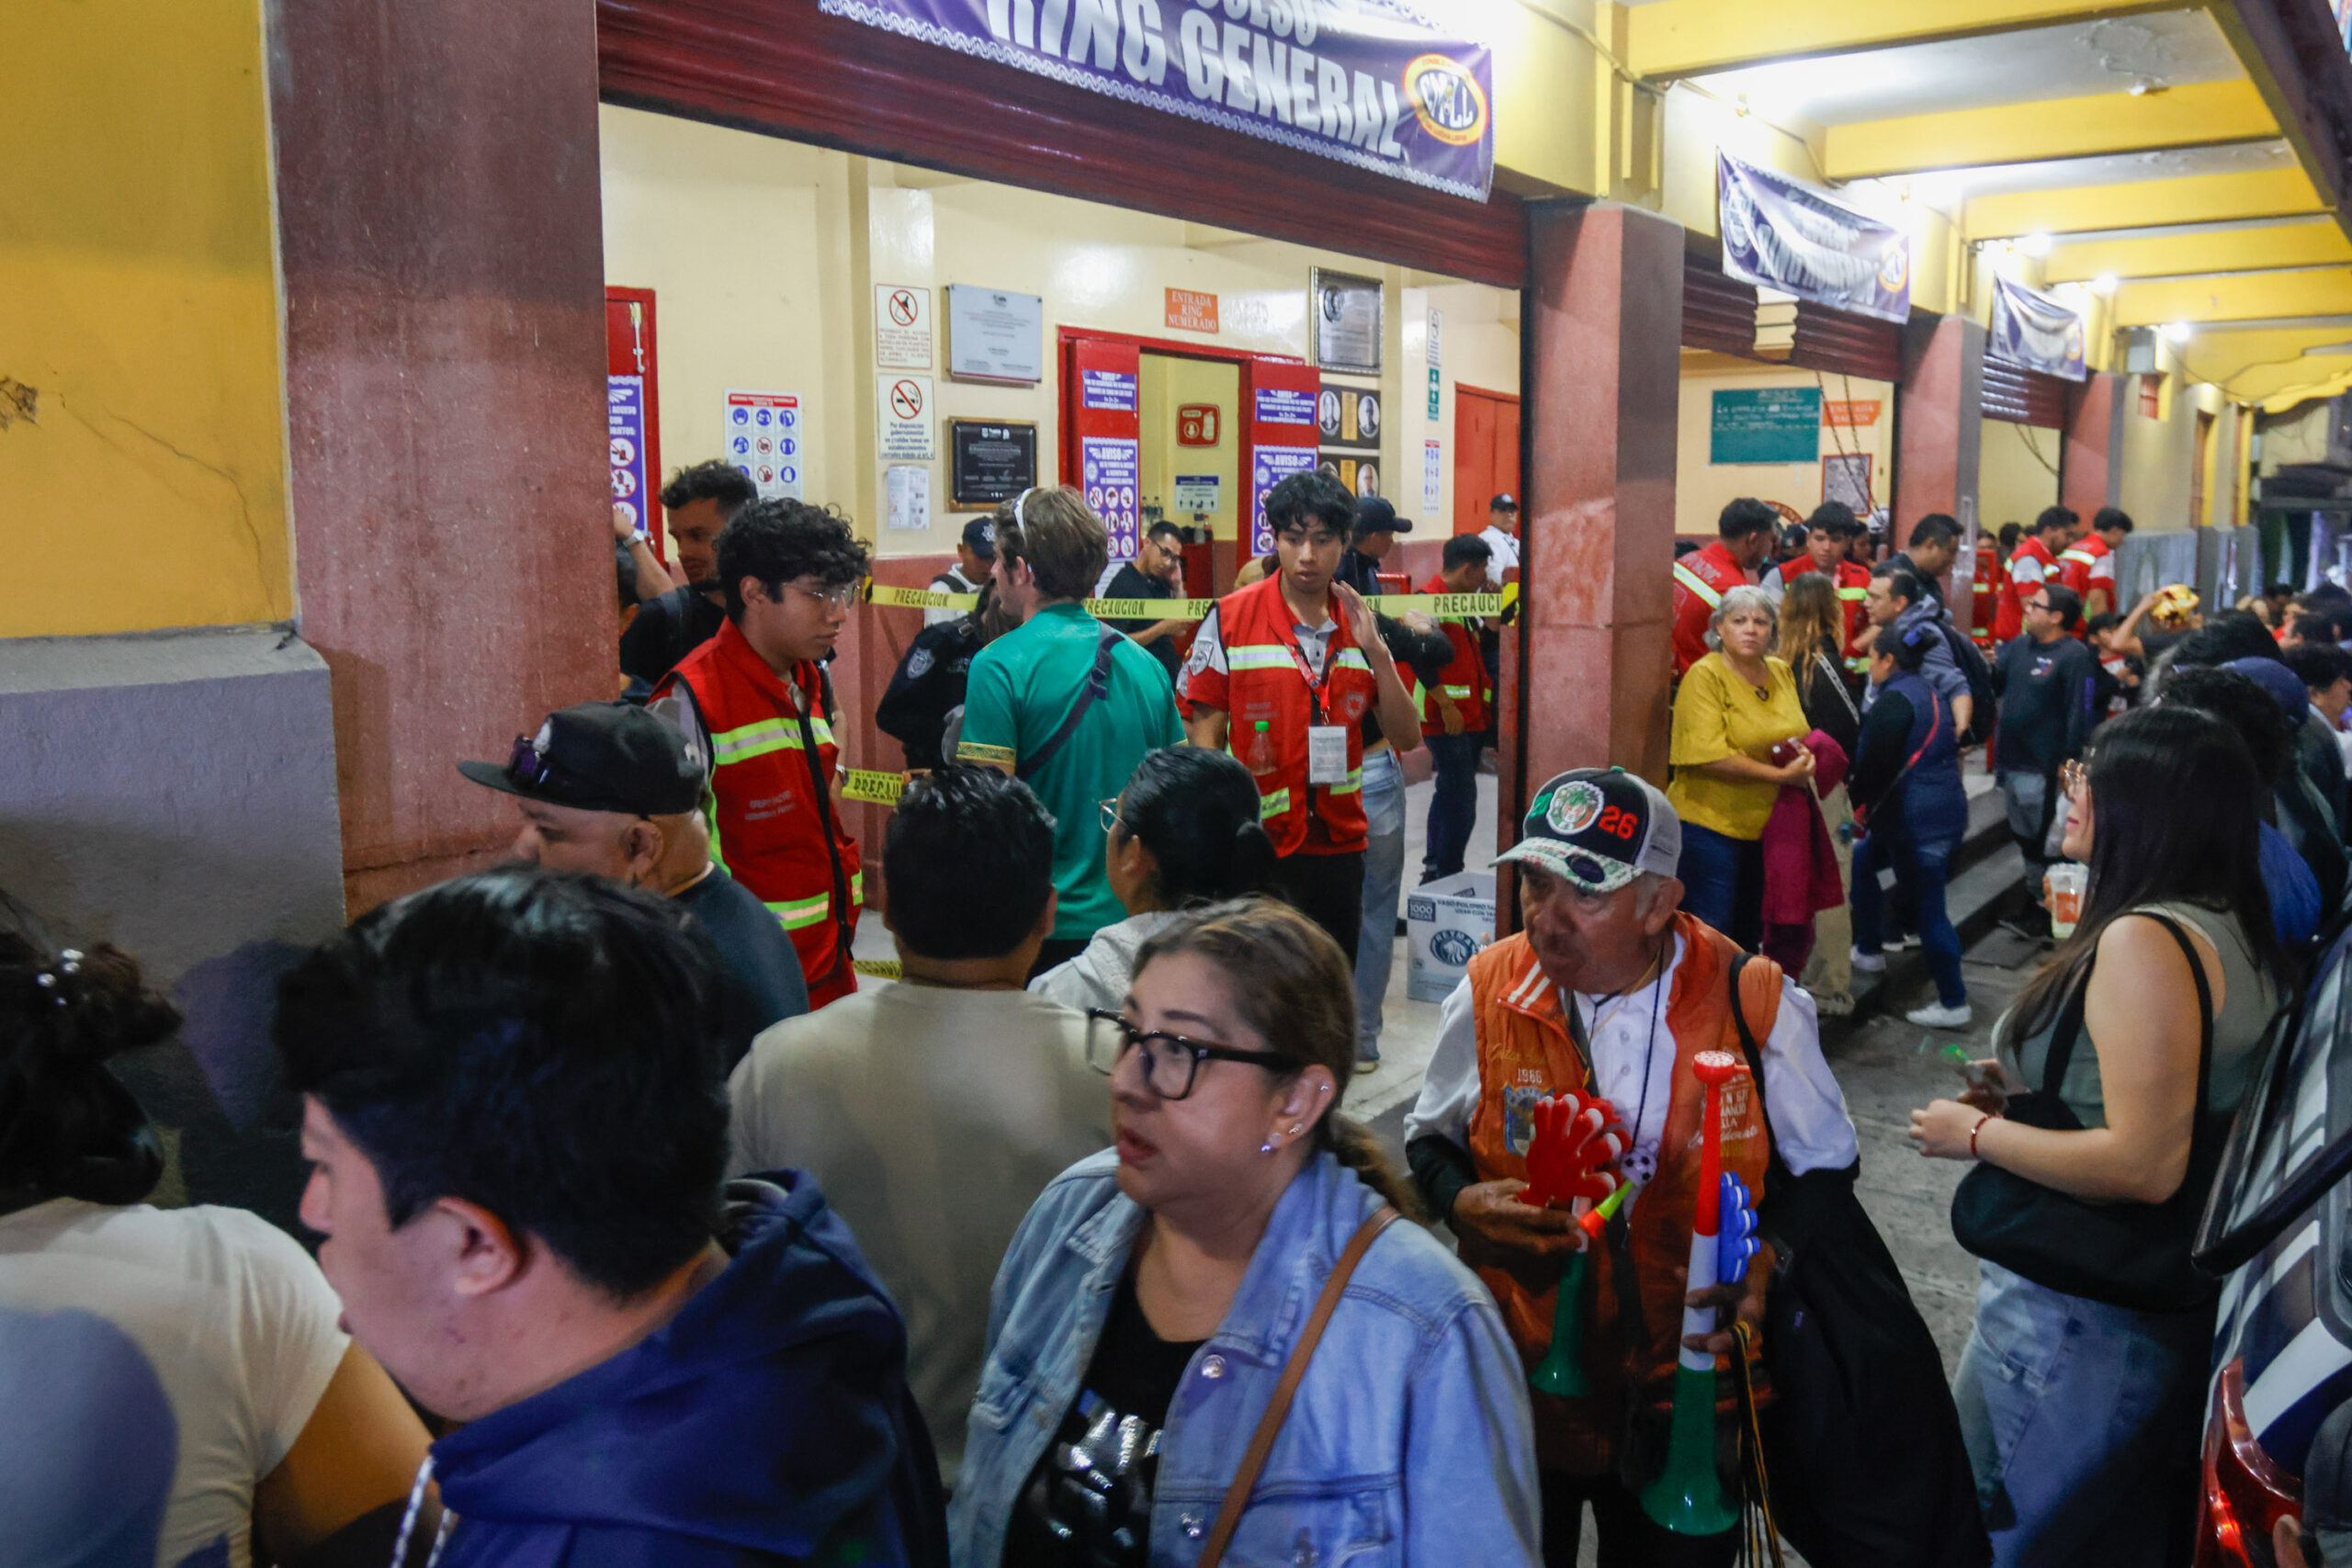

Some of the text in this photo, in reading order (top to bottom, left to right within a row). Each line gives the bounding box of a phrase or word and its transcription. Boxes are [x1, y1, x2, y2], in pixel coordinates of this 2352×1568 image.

[1180, 8, 1402, 159] GENERAL
[1171, 290, 1212, 308] ENTRADA
[1182, 304, 1203, 317] RING
[1168, 313, 1216, 332] NUMERADO
[1829, 404, 1874, 412] ENTADA
[1102, 446, 1122, 460] AVISO
[1274, 454, 1297, 467] AVISO
[894, 589, 949, 607] PRECAUCION
[1433, 593, 1500, 613] PRECAUCI
[1599, 805, 1638, 840] 26
[1409, 903, 1433, 917] 1000
[1434, 928, 1476, 948] REYMA
